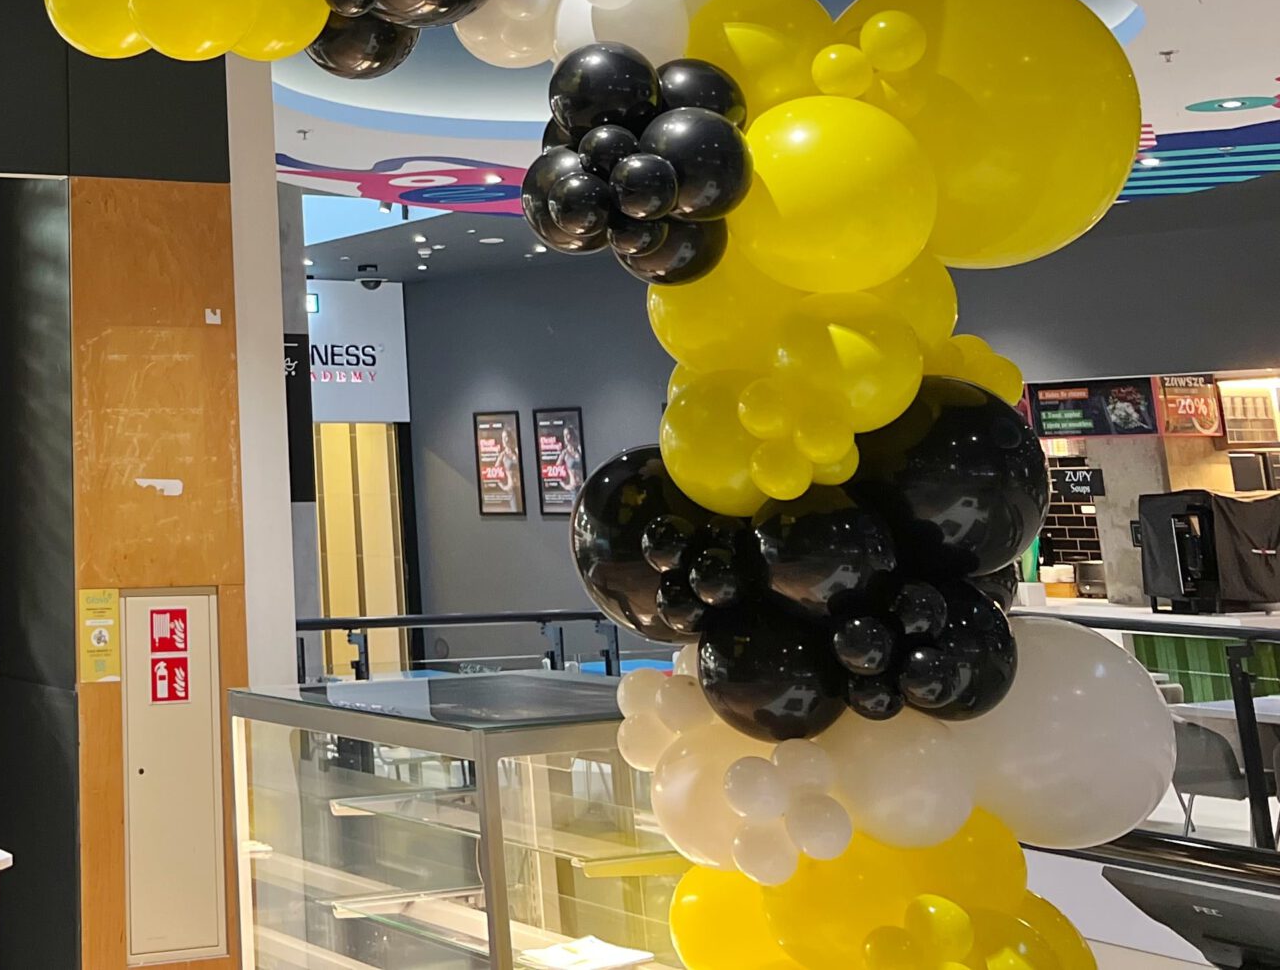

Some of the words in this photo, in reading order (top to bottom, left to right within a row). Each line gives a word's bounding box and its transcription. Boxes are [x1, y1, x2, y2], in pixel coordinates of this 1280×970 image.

[310, 344, 377, 366] NESS
[1167, 397, 1208, 416] -20%
[542, 465, 567, 477] -20%
[1065, 470, 1092, 482] ZUPY
